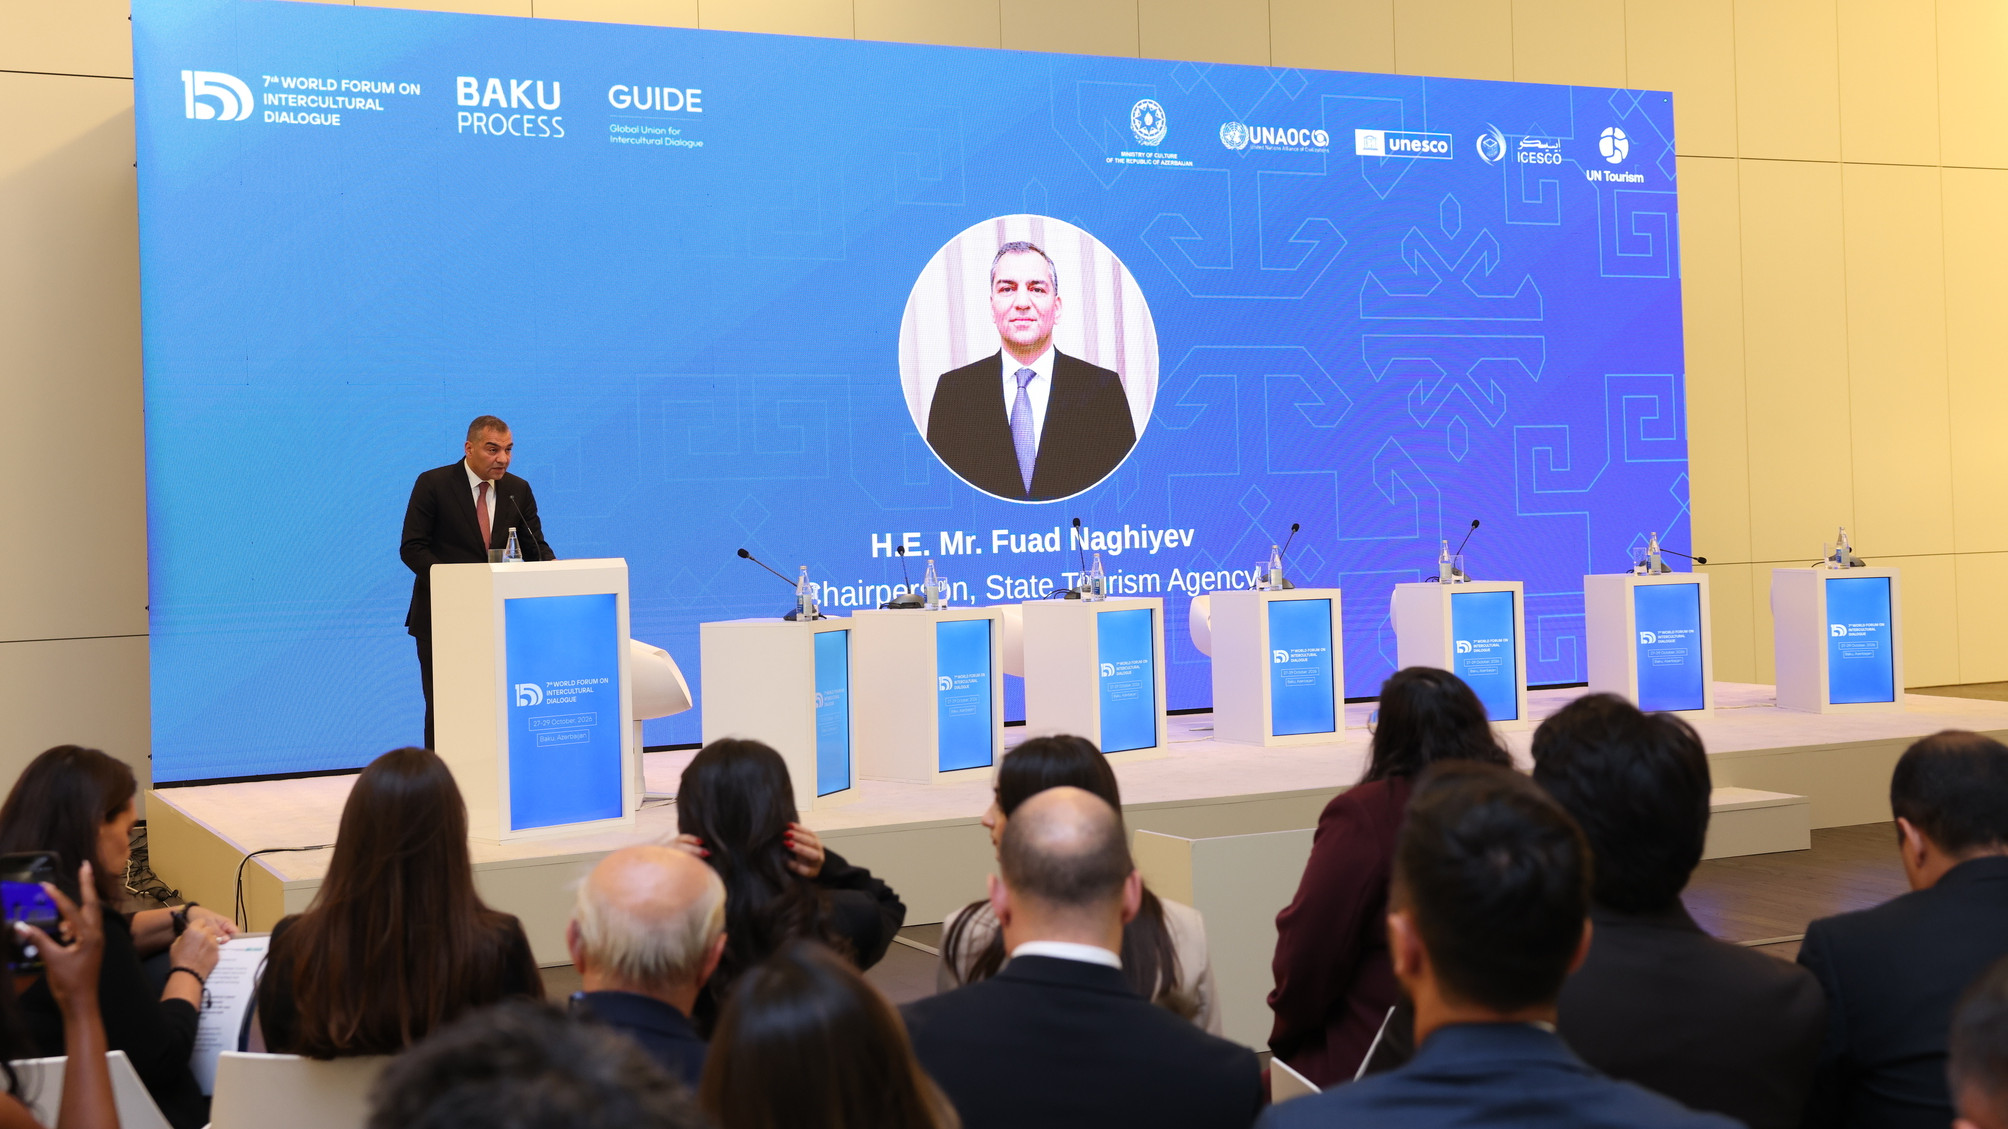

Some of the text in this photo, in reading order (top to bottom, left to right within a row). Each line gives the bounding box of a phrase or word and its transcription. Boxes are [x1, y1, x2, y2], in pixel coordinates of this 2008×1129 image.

[262, 75, 421, 95] 7th WORLD FORUM ON
[456, 76, 561, 110] BAKU
[263, 93, 384, 111] INTERCULTURAL
[607, 84, 703, 112] GUIDE
[264, 110, 341, 126] DIALOGUE
[457, 112, 565, 138] PROCESS
[609, 123, 681, 135] Global Union for
[1249, 126, 1311, 147] UNAOC
[609, 135, 704, 149] Intercultural Dialogue
[1389, 138, 1448, 153] unesco
[1517, 151, 1562, 165] ICESCO
[1586, 169, 1644, 183] UN Tourism
[871, 524, 1195, 558] H.E. Mr. Fuad Naghiyev
[986, 575, 1054, 600] State
[1167, 568, 1259, 597] Agency
[554, 679, 576, 687] WORLD
[546, 687, 594, 696] INTERCULTURAL
[546, 696, 577, 704] DIALOGUE
